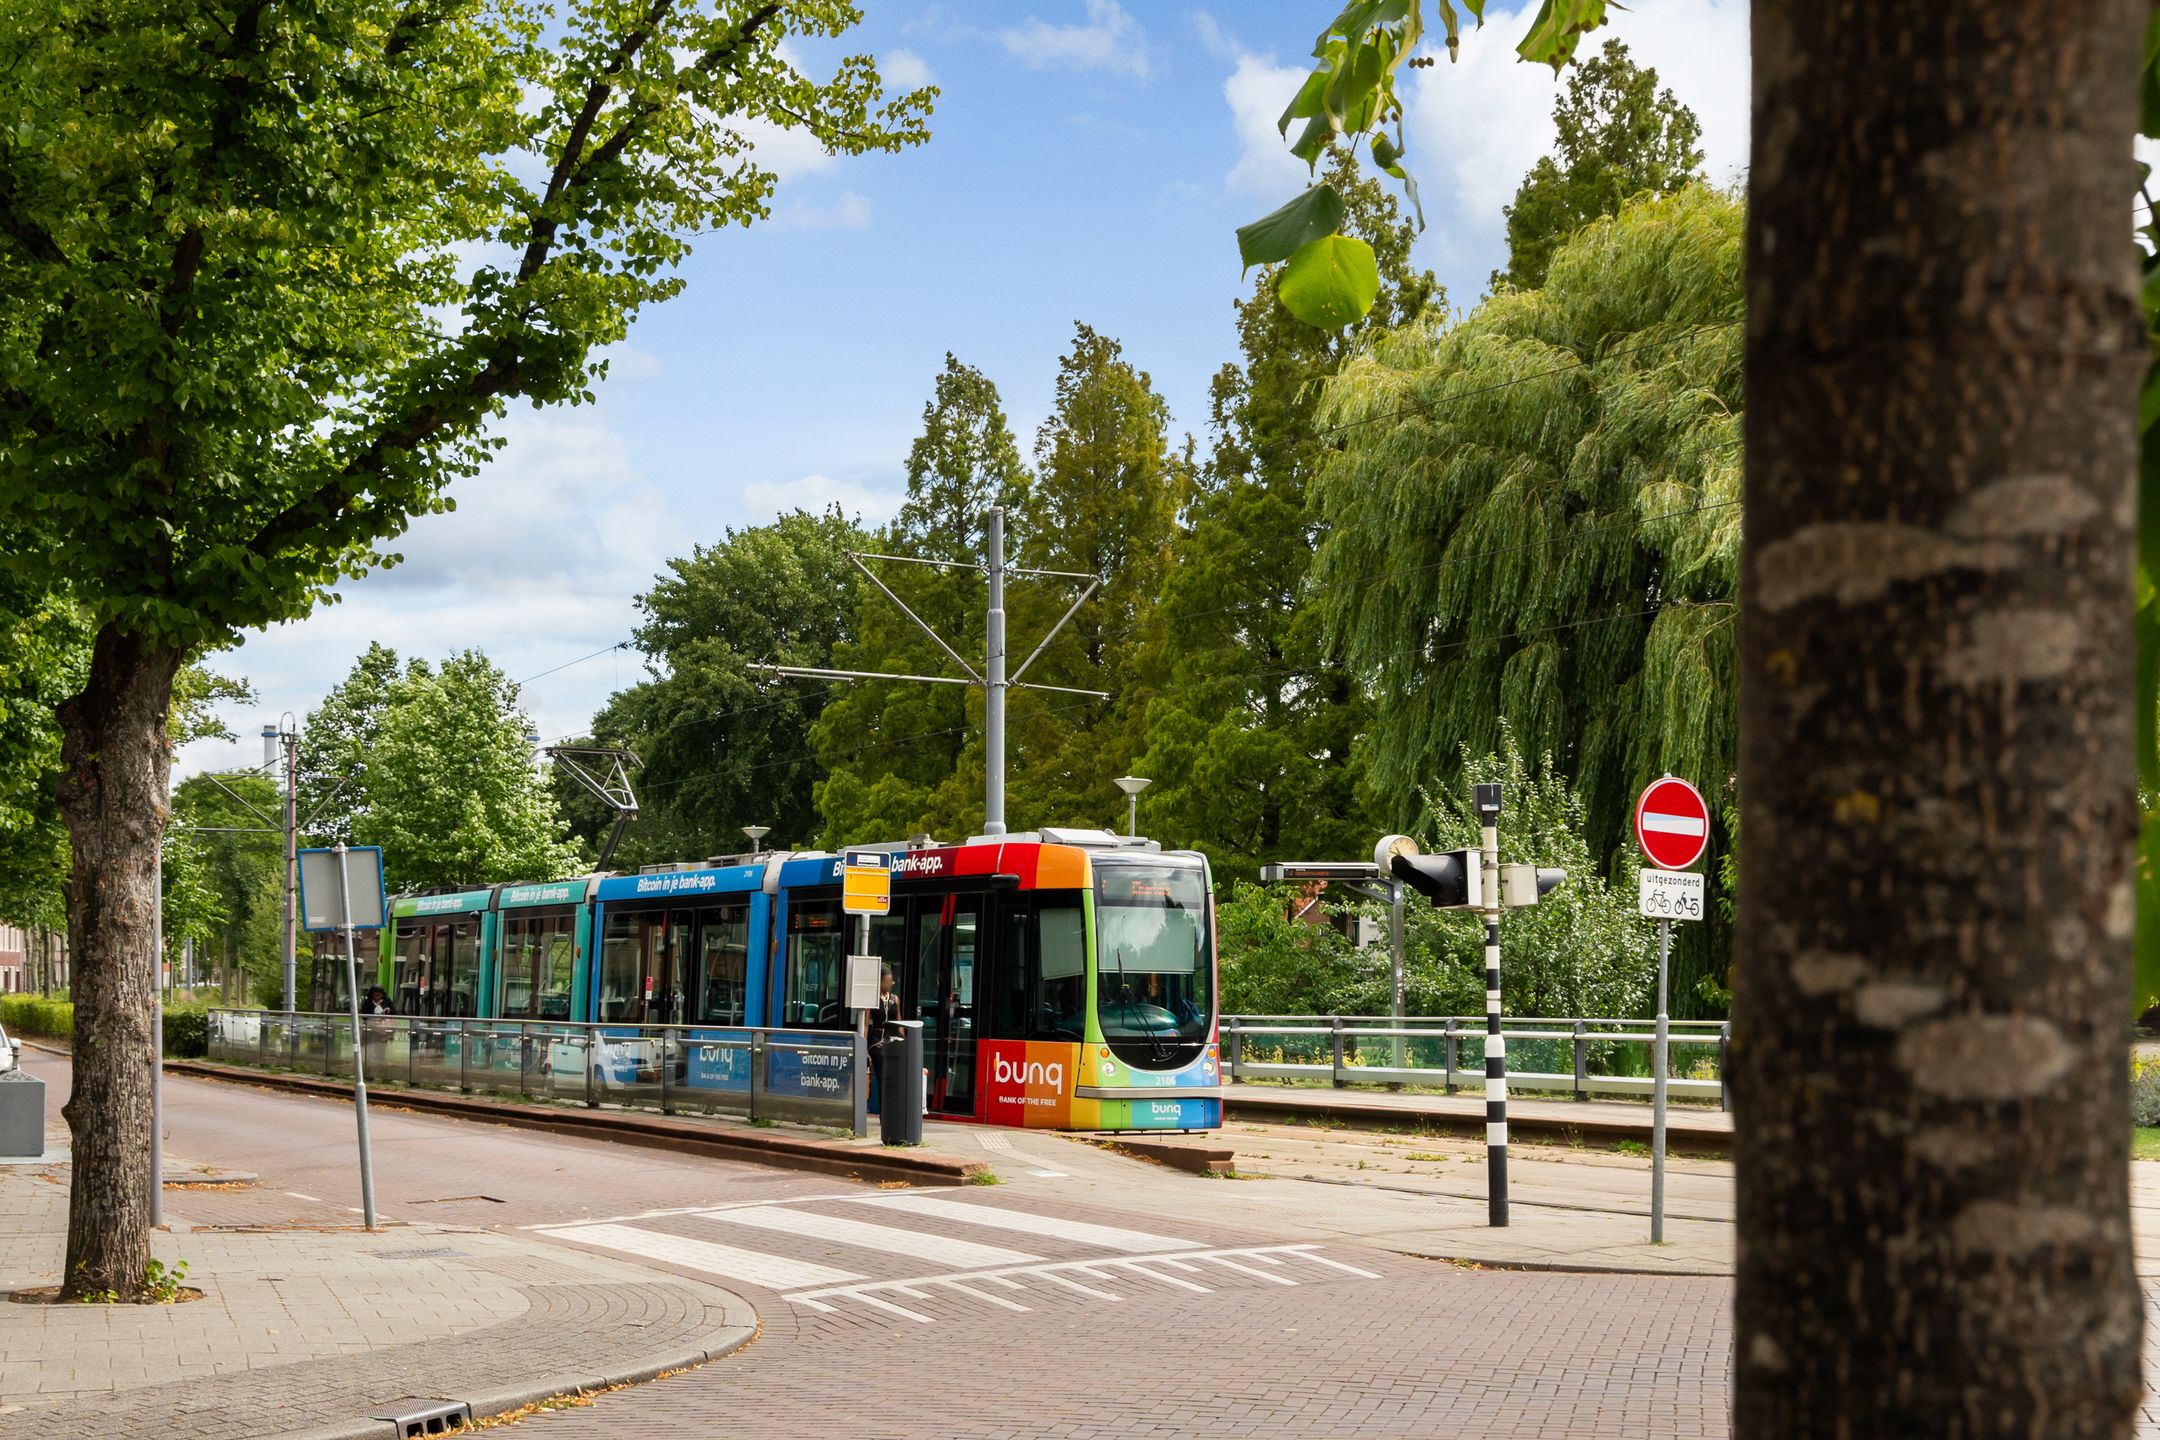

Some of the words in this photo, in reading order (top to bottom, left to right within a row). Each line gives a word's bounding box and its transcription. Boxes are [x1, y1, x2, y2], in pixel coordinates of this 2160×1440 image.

[892, 854, 942, 874] bank-app.
[637, 877, 661, 892] Bitcoin
[662, 875, 670, 890] in
[669, 874, 678, 893] je
[679, 873, 716, 890] bank-app.
[1646, 874, 1700, 888] uitgezonderd
[800, 1072, 840, 1092] bank-app.
[995, 1051, 1063, 1095] bunq
[1155, 1075, 1177, 1086] 2106
[998, 1095, 1017, 1104] BANK
[1017, 1097, 1026, 1105] OF
[1027, 1098, 1040, 1106] THE
[1040, 1098, 1057, 1107] FREE
[1151, 1101, 1182, 1117] bunq
